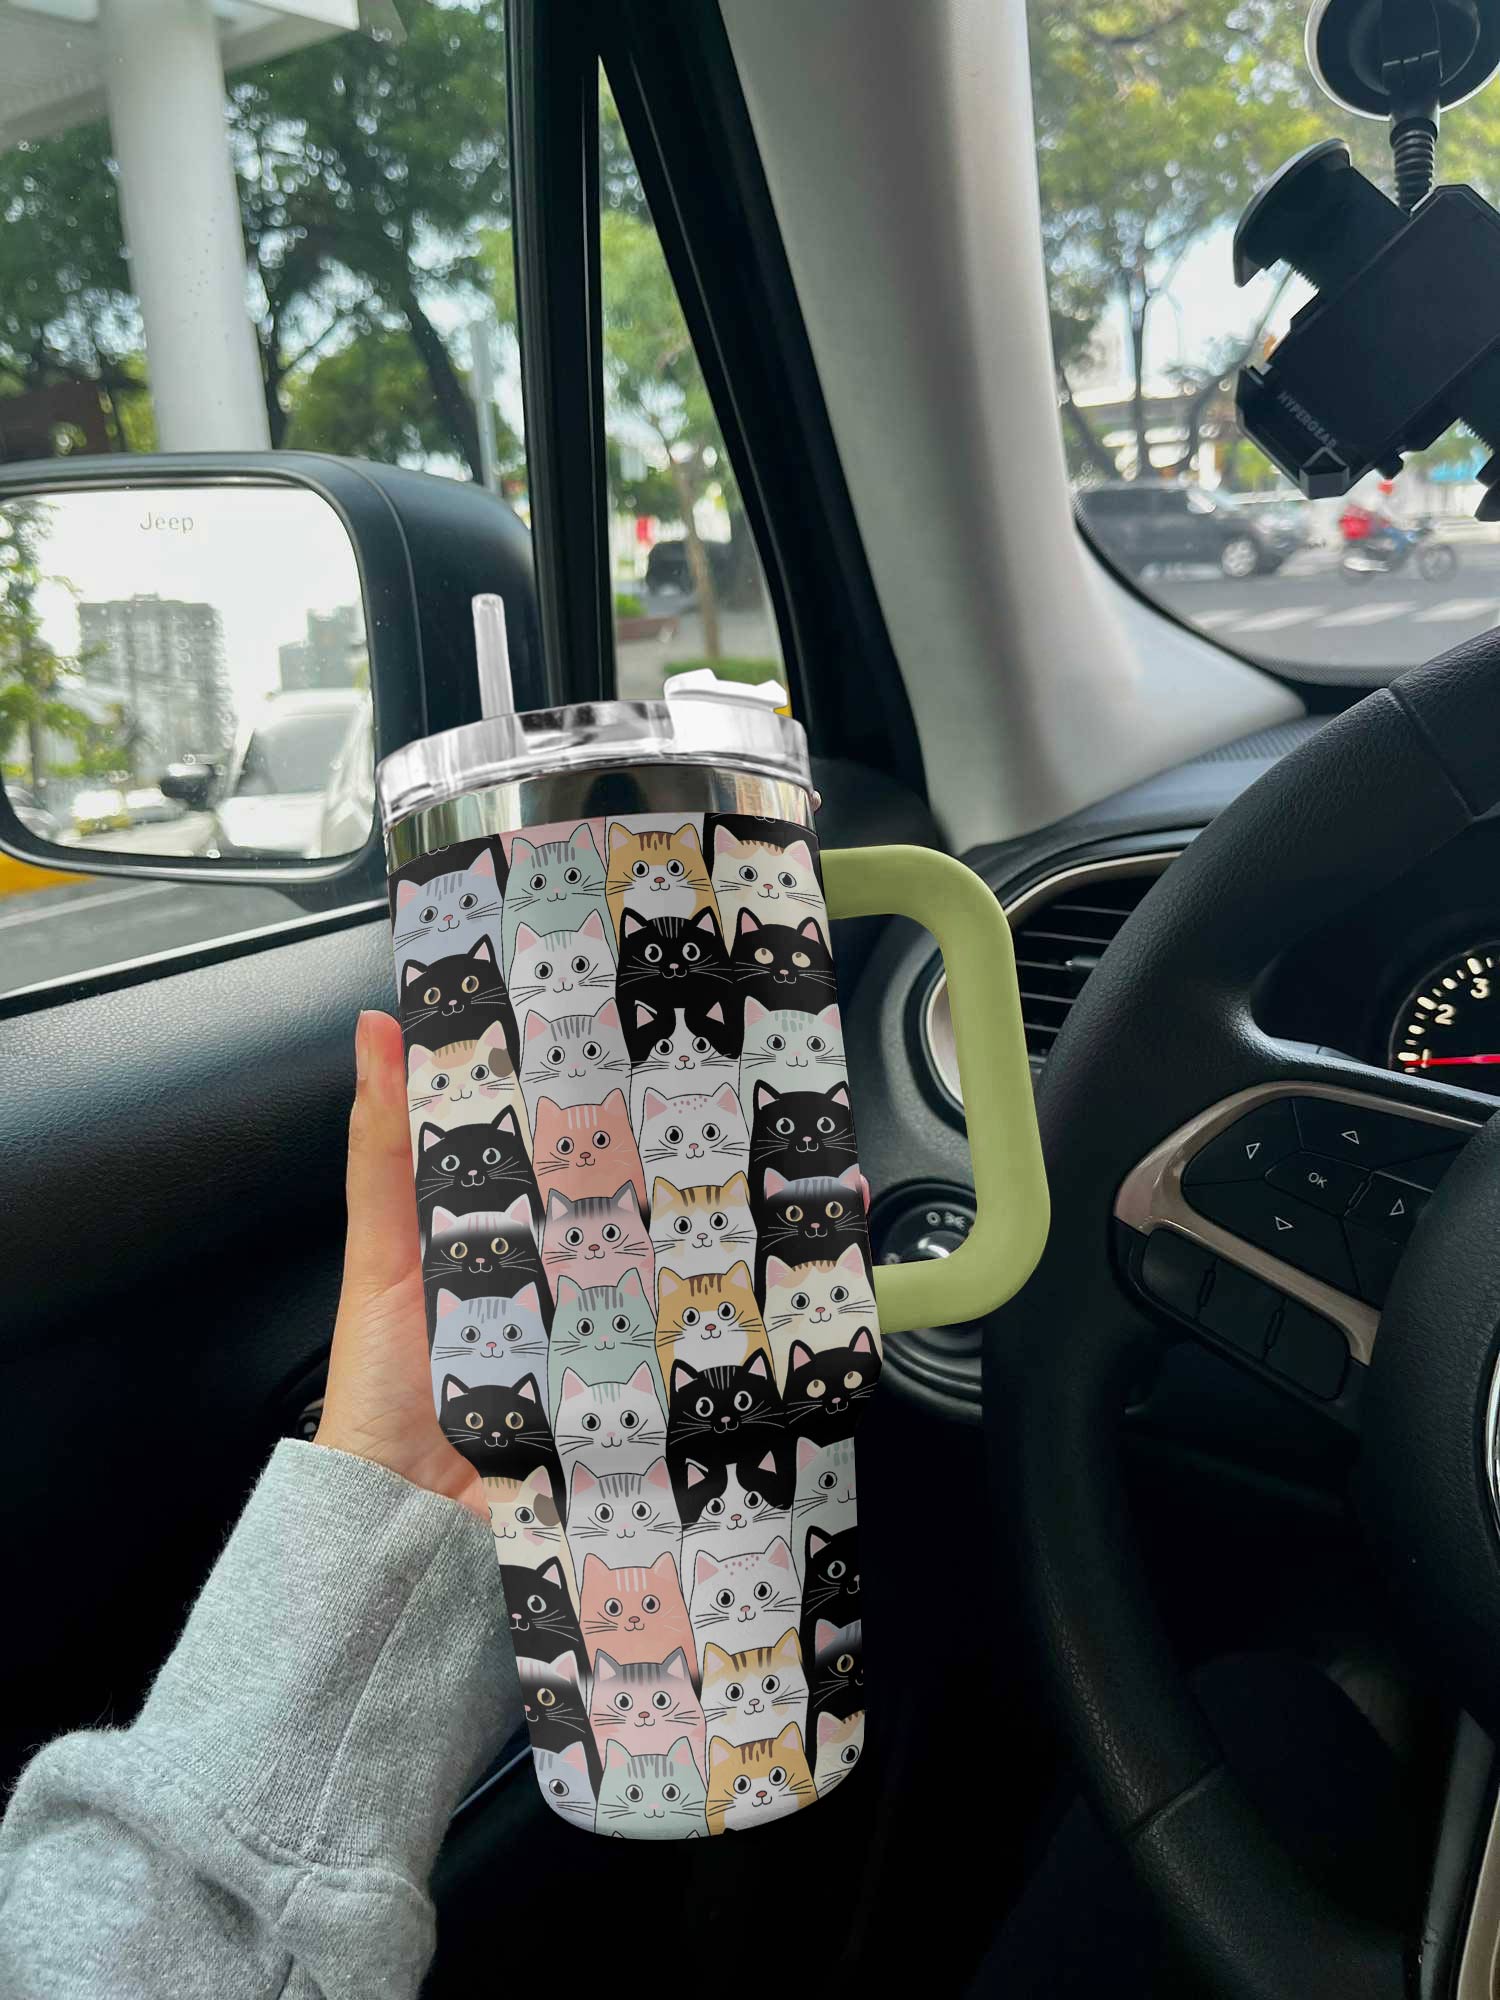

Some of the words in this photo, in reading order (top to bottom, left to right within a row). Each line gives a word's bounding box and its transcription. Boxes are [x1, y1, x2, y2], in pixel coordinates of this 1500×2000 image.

[1277, 390, 1337, 448] HYPERGEAR
[140, 511, 194, 534] Jeep
[1470, 977, 1490, 1000] 3
[1434, 1003, 1456, 1026] 2
[1308, 1171, 1328, 1189] OK
